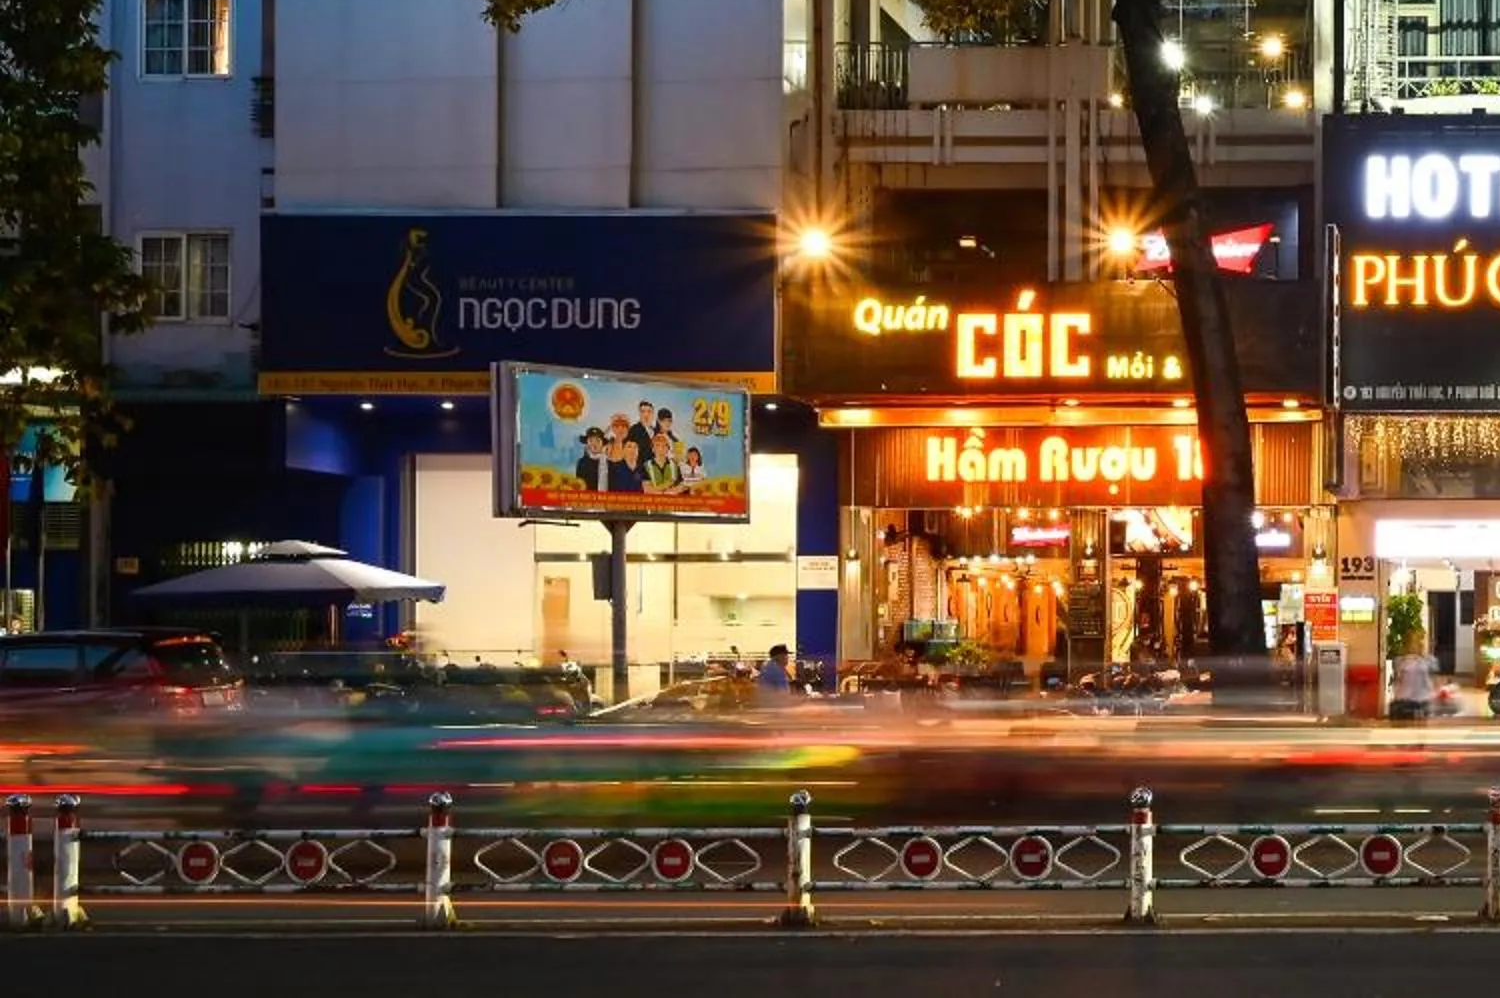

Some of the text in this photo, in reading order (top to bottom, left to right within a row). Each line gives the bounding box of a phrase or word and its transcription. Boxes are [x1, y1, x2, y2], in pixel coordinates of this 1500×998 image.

[1352, 238, 1479, 307] PHÚ
[853, 290, 1091, 379] Quán CÓC
[926, 427, 1028, 482] Hầm
[1039, 435, 1157, 495] Rượu
[1341, 556, 1375, 573] 193
